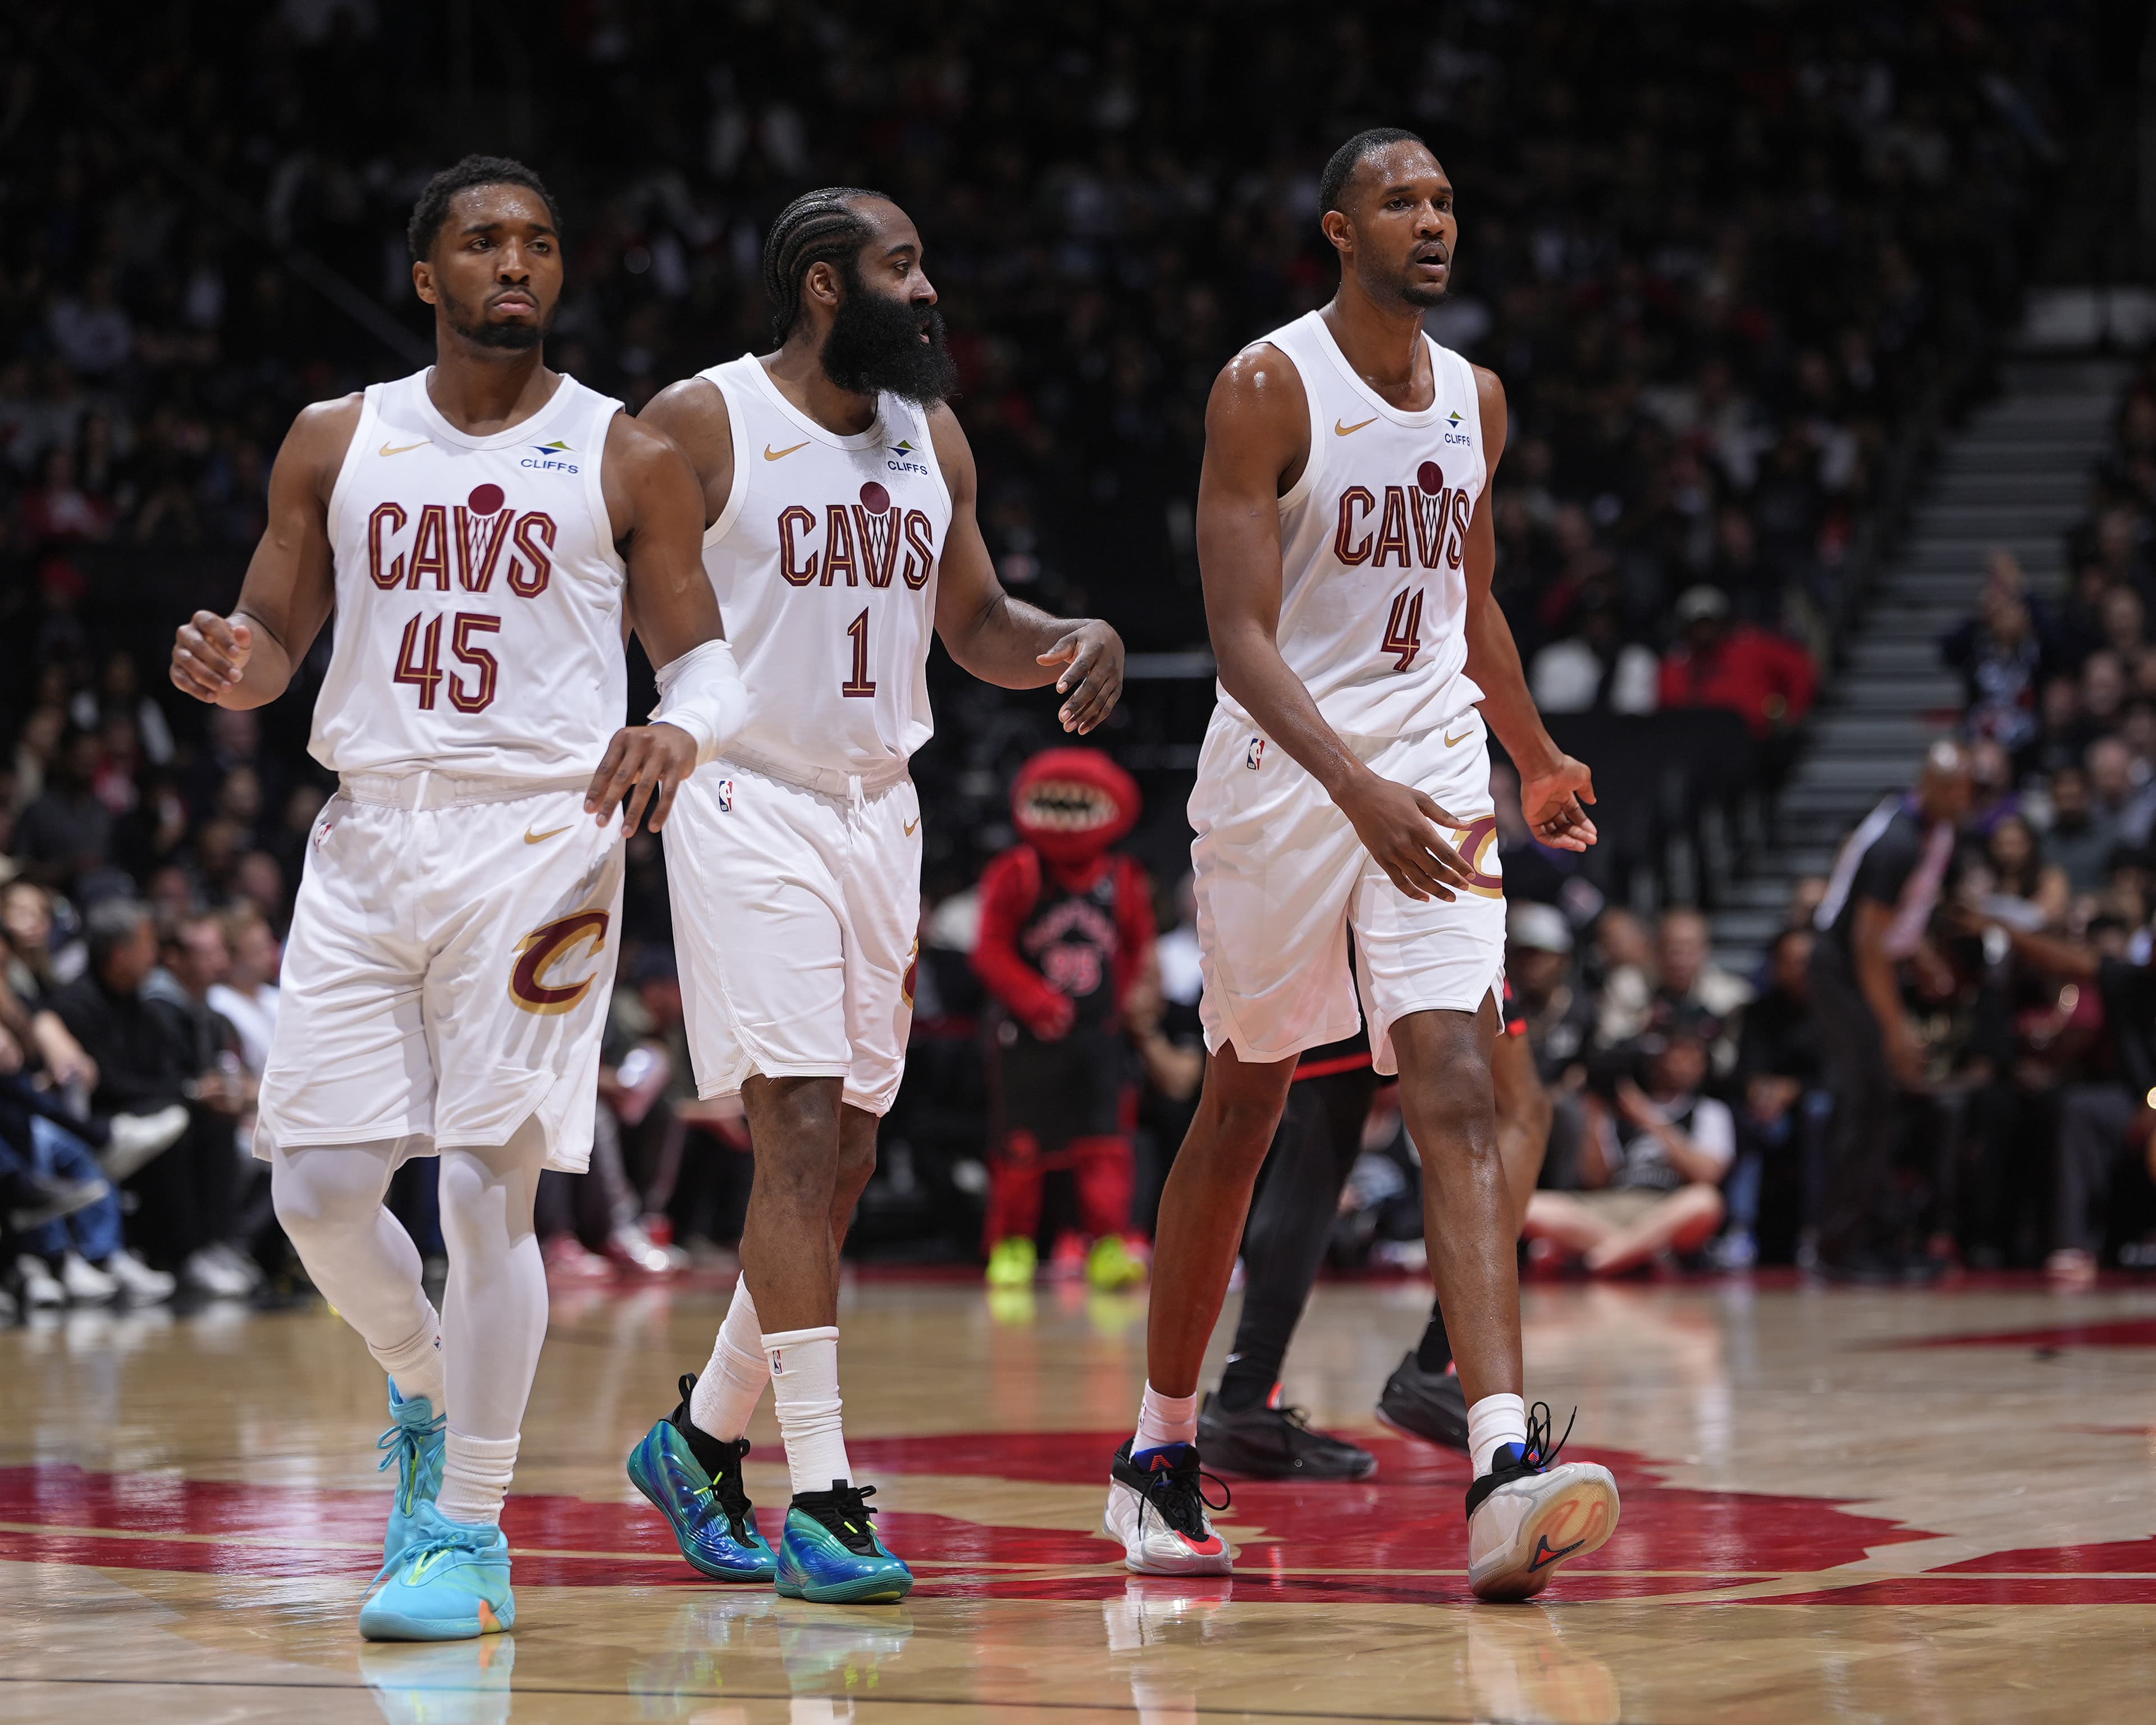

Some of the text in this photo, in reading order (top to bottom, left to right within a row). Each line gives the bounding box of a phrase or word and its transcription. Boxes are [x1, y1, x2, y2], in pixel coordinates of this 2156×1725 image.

[520, 458, 579, 474] CLIFFS
[888, 460, 928, 476] CLIFFS
[1445, 433, 1471, 447] CLIFFS
[368, 501, 557, 599] CAVS
[778, 504, 934, 591] CAVS
[1334, 485, 1470, 570] CAVS
[393, 611, 501, 714] 45
[843, 606, 876, 698] 1
[1380, 586, 1424, 672] 4
[509, 909, 610, 1016] C
